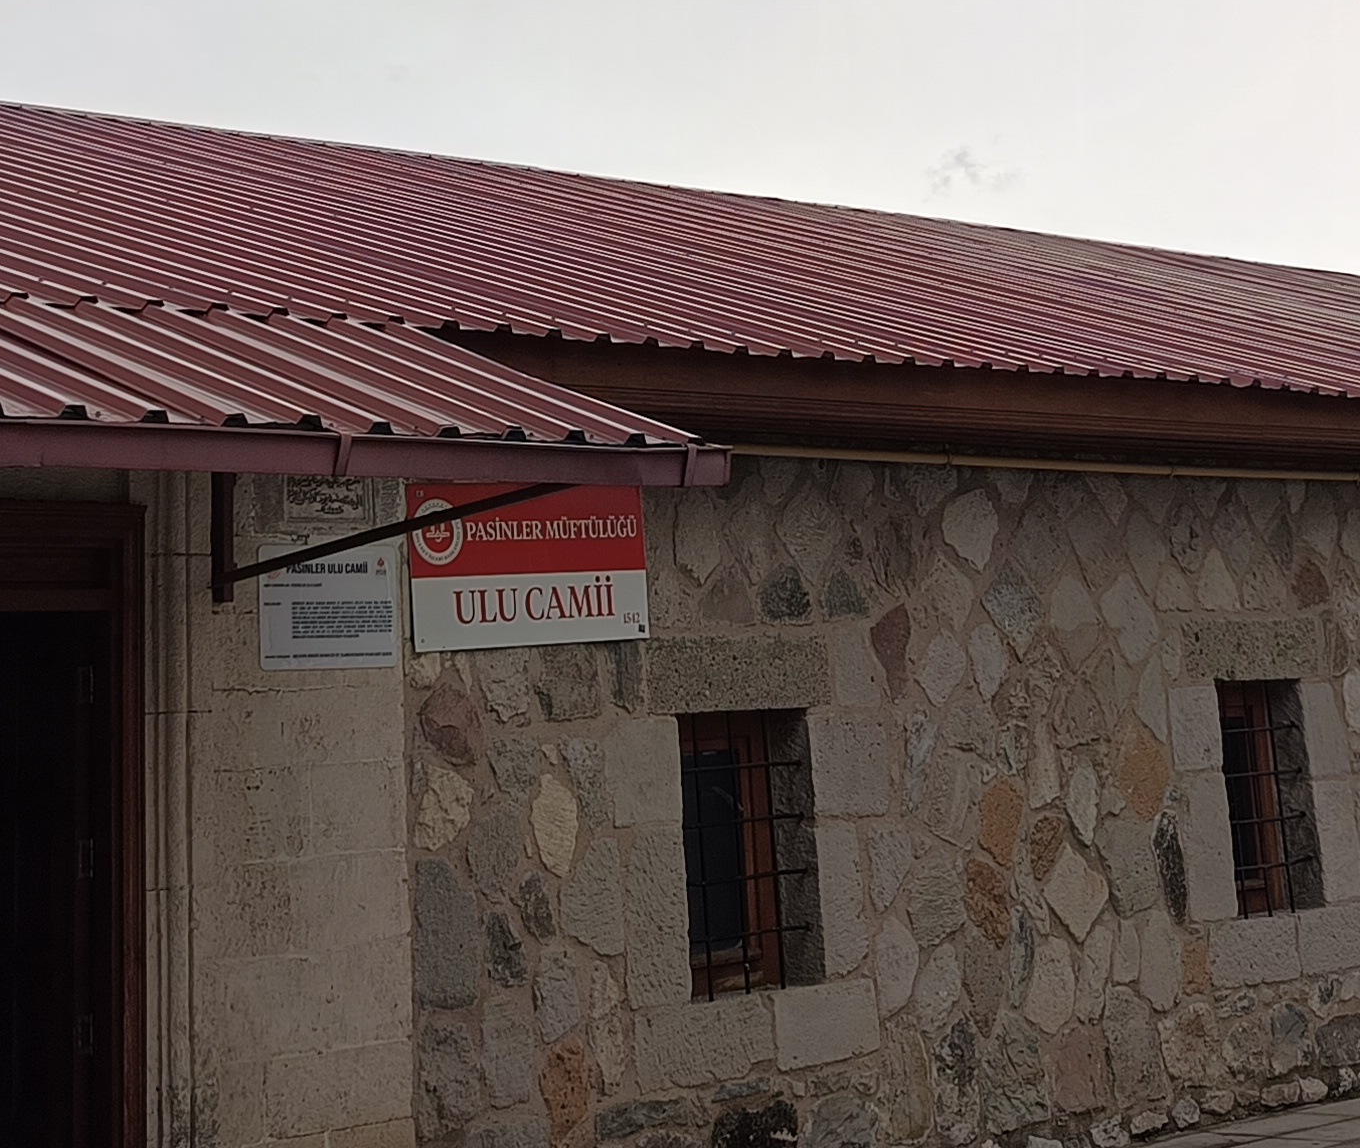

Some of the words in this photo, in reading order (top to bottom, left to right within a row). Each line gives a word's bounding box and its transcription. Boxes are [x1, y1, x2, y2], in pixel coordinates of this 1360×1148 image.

[466, 516, 544, 541] PASİNLER
[545, 514, 638, 540] MÜFTÜLÜĞÜ
[327, 563, 344, 574] ULU
[345, 561, 368, 574] CAMİİ
[453, 588, 518, 624] ULU
[525, 575, 616, 621] CAMİİ
